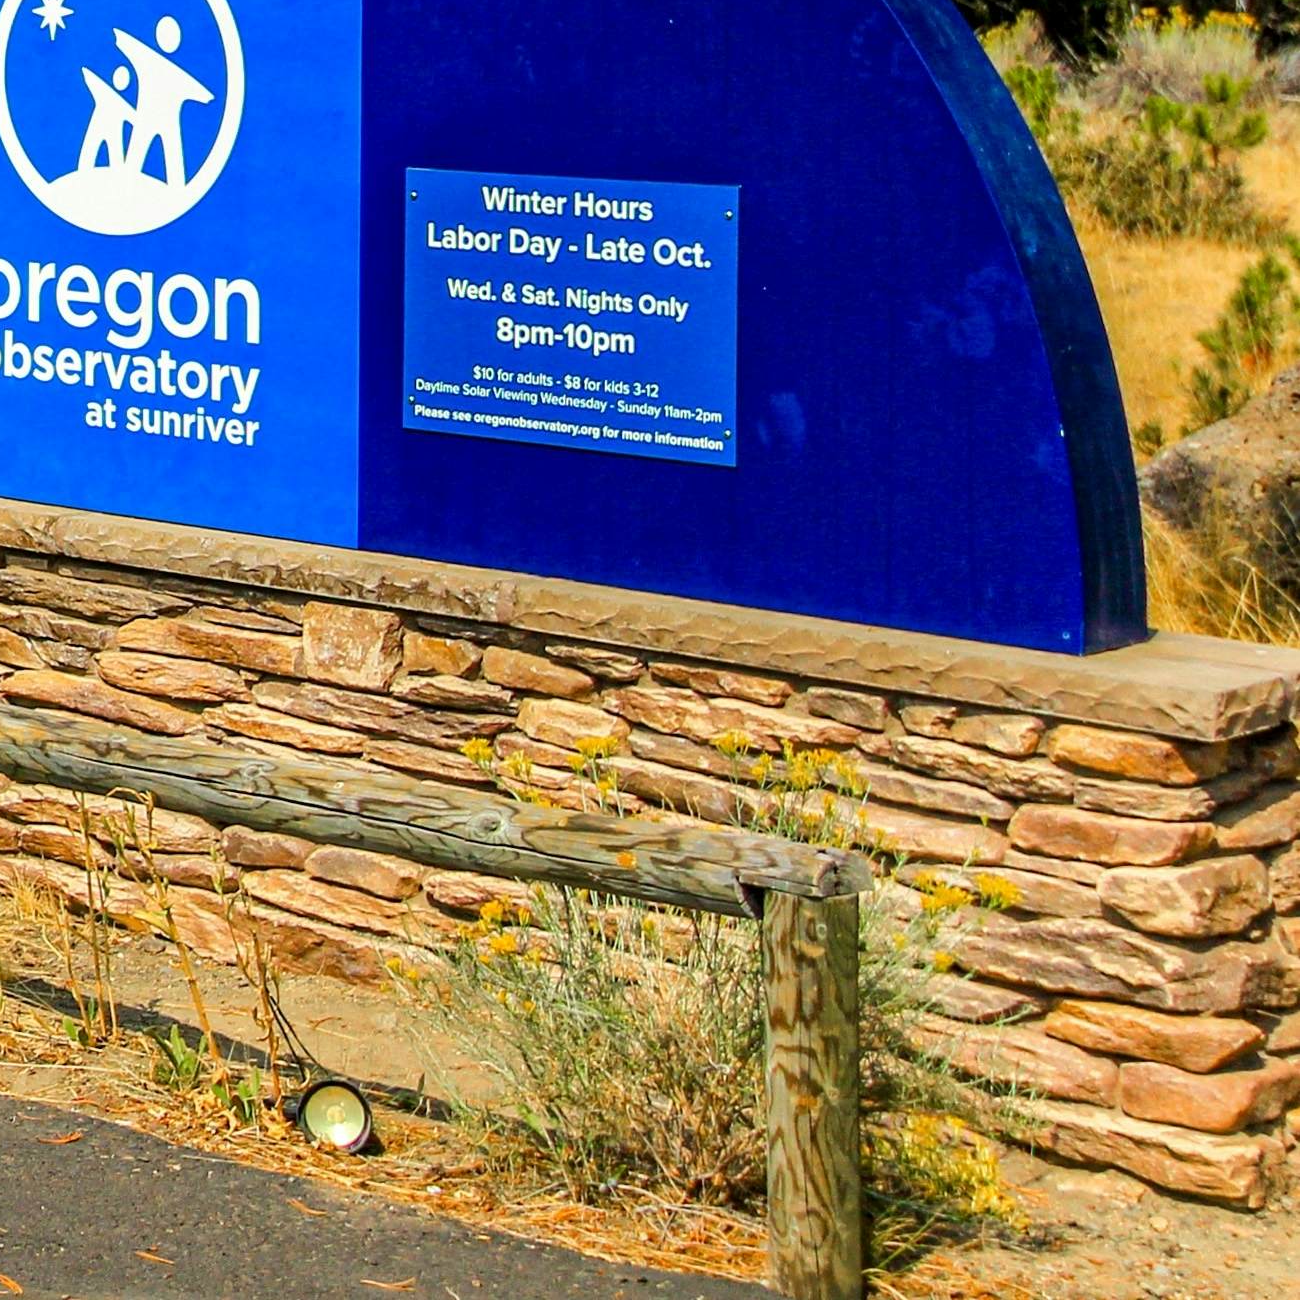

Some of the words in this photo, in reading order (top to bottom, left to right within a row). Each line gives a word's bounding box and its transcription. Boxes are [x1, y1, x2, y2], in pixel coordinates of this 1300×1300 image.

[482, 186, 567, 215] Winter
[573, 192, 654, 221] Hours
[427, 223, 502, 253] Labor
[509, 228, 561, 262] Day
[585, 234, 646, 263] Late
[653, 238, 711, 268] Oct.
[447, 278, 497, 301] Wed.
[502, 283, 516, 303] &
[521, 284, 560, 307] Sat.
[566, 288, 633, 314] Nights
[638, 294, 688, 322] Only
[496, 317, 635, 356] 8pm-10pm
[415, 378, 460, 395] Daytime
[462, 384, 490, 398] Solar
[493, 387, 538, 405] Viewing
[540, 391, 607, 413] Wednesday
[617, 400, 661, 419] Sunday
[664, 405, 722, 424] 11am-2pm
[473, 364, 494, 380] $10
[497, 368, 514, 382] for
[516, 371, 553, 386] adults
[564, 374, 581, 390] $8
[584, 377, 600, 391] for
[604, 379, 630, 395] kids
[633, 382, 659, 398] 3-12
[85, 398, 116, 428] at
[126, 405, 260, 446] sunriver
[414, 404, 450, 419] Please
[452, 409, 471, 422] see
[474, 413, 600, 439] oregonobservatory.org
[602, 426, 619, 438] for
[622, 430, 652, 442] more
[655, 432, 723, 451] information
